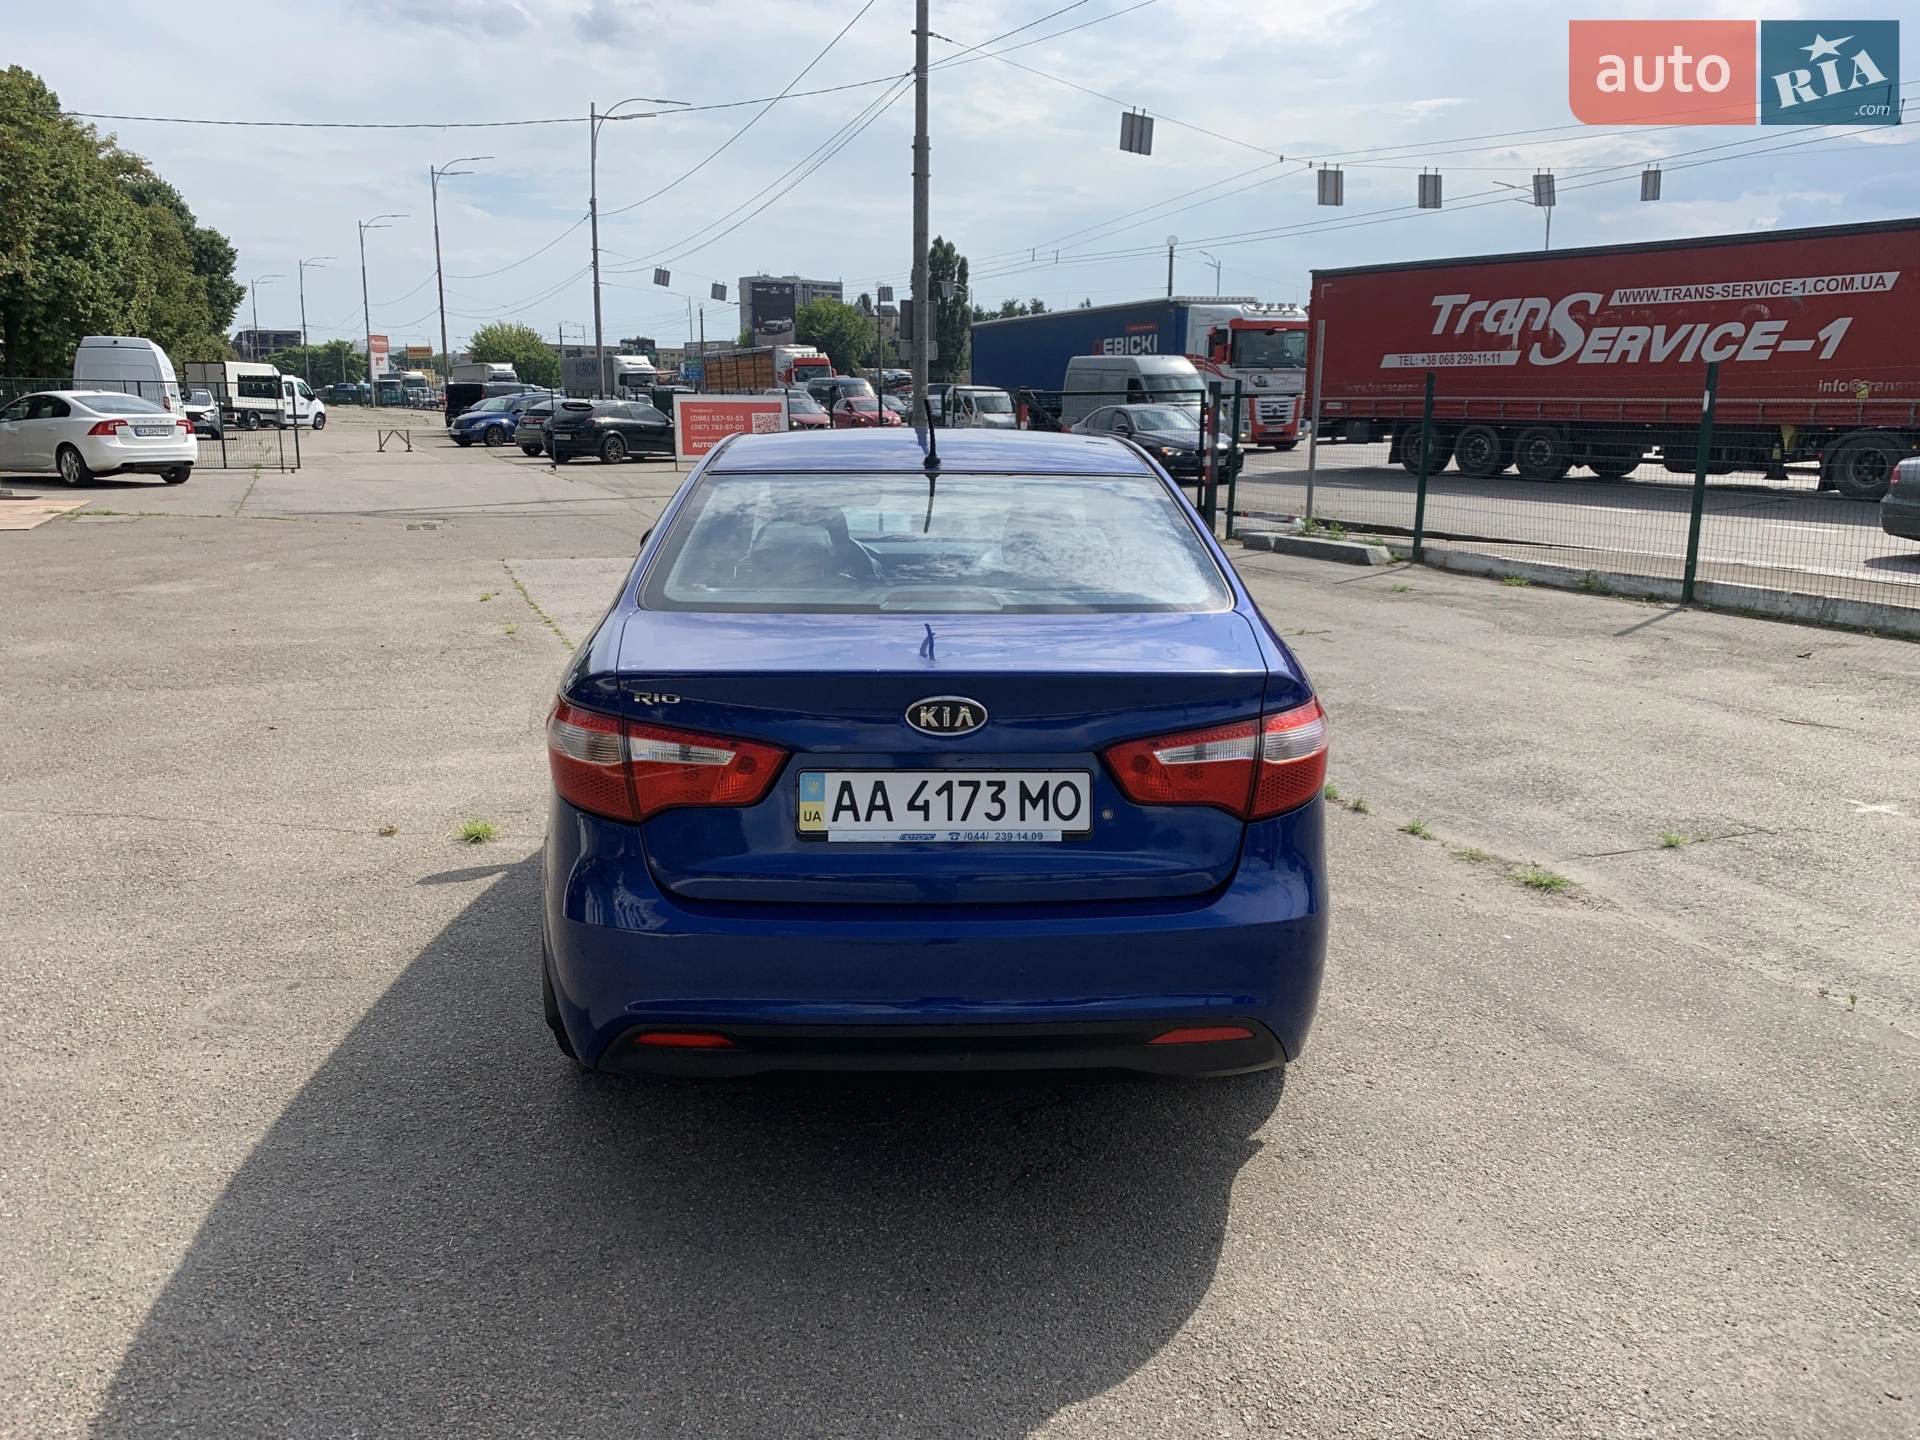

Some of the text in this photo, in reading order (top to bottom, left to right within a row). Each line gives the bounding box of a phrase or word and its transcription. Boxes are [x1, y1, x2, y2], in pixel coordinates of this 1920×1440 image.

[1618, 274, 1888, 304] WWW.TRANS-SERVICE-1.COM.UA
[1398, 352, 1501, 366] TEL: +38 068 299-11-11
[633, 691, 681, 705] RIO
[919, 705, 976, 727] KIA
[831, 780, 1082, 822] AA 4173 MO
[803, 810, 822, 822] UA
[964, 833, 1044, 841] /044/ 239 14 09
